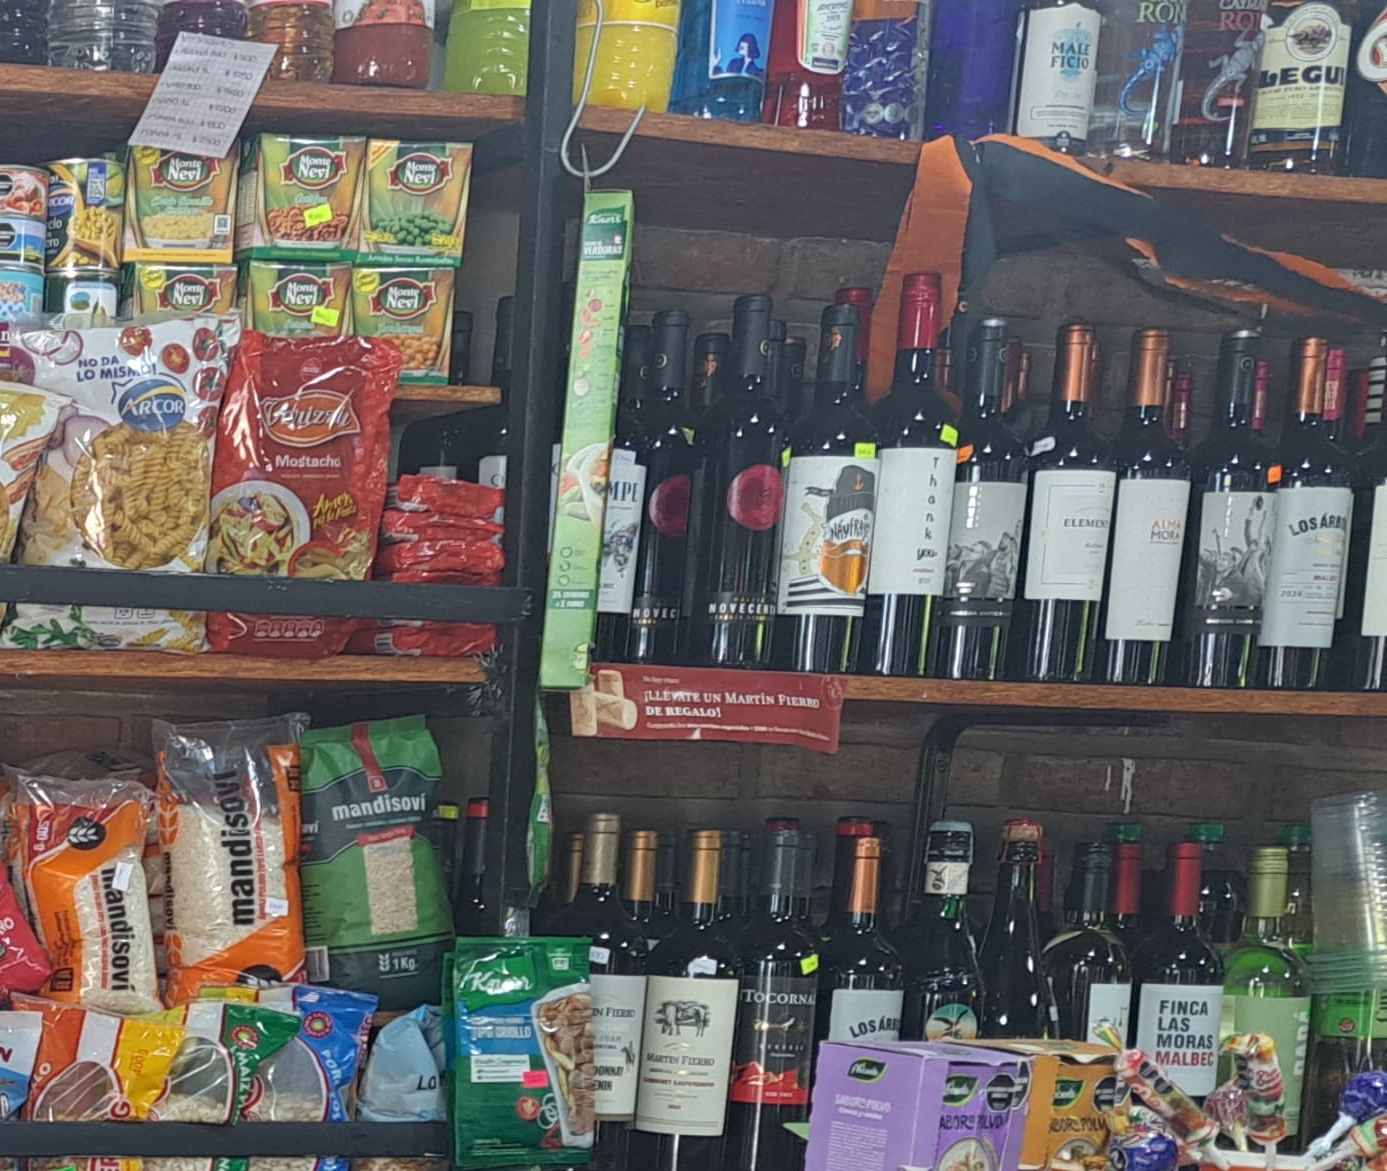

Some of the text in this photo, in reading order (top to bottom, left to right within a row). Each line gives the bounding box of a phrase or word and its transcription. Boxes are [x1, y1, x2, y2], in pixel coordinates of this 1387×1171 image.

[170, 154, 203, 170] Monte
[299, 153, 331, 169] Monte
[405, 160, 438, 176] Monte
[175, 280, 206, 294] Monte
[286, 279, 318, 294] Monte
[389, 285, 420, 299] Monte
[77, 356, 120, 370] NO DA
[76, 368, 96, 382] LO
[119, 396, 186, 417] ARCOR
[1287, 516, 1318, 537] LOS
[702, 690, 723, 704] UN
[724, 691, 776, 707] MARTÍN
[777, 693, 821, 709] FIERRO
[645, 705, 723, 719] DE REGALO!
[331, 791, 427, 822] mandisoví
[99, 865, 137, 992] mandisoví
[1158, 998, 1210, 1017] FINCA
[849, 1021, 876, 1039] LOS
[1157, 1015, 1191, 1033] LAS
[1156, 1031, 1213, 1050] MORAS
[647, 1053, 715, 1067] MARTIN FIERRO
[1153, 1049, 1215, 1068] MALBEC
